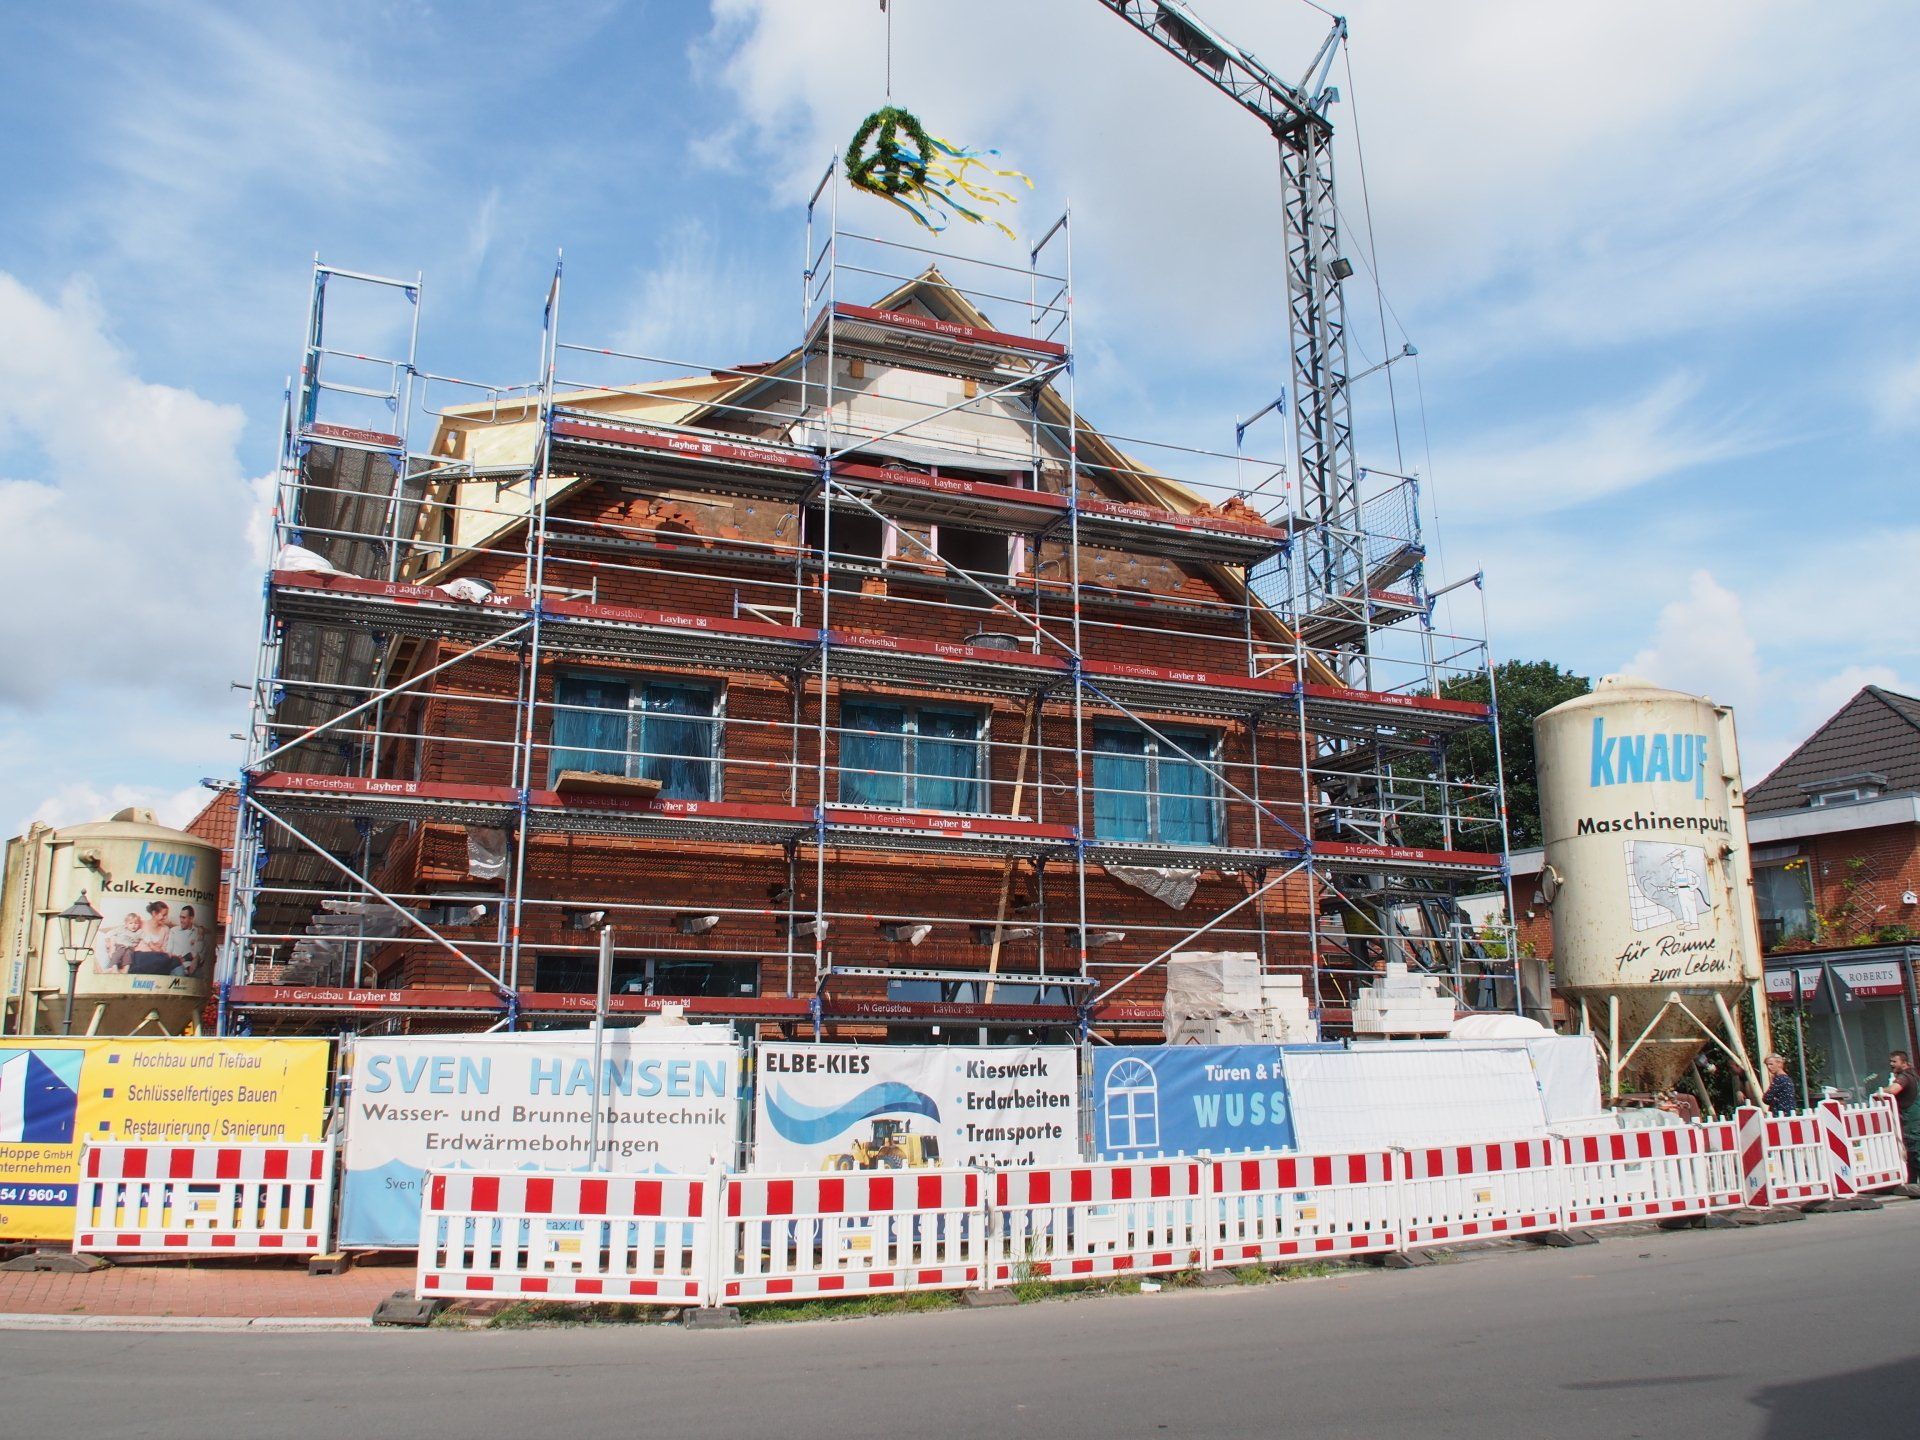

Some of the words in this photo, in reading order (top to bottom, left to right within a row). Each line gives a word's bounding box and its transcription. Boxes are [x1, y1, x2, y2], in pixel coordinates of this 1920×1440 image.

[935, 322, 963, 335] Layher
[668, 438, 701, 452] Layher
[934, 478, 963, 490] Layher
[659, 614, 693, 626] Layher
[935, 643, 963, 656] Layher
[1169, 670, 1195, 682] Layher
[1590, 716, 1708, 800] KNAUF
[366, 780, 403, 794] Layher
[649, 800, 684, 813] Layher
[928, 817, 960, 830] Layher
[1577, 811, 1729, 836] Maschinenputz
[136, 840, 197, 886] KNAUF
[1772, 975, 1819, 988] CARINE
[1849, 970, 1894, 983] ROBERTS
[348, 991, 387, 1004] Layher
[1133, 1008, 1165, 1017] Gerüstba
[132, 1052, 187, 1069] Hochbau
[190, 1053, 214, 1069] und
[218, 1053, 262, 1069] Tiefbau
[766, 1052, 870, 1075] ELBE-KIES
[966, 1058, 1048, 1079] Kieswerk
[365, 1054, 492, 1094] SVEN
[529, 1058, 727, 1098] HANSEN
[1205, 1063, 1251, 1082] Türen
[1255, 1063, 1268, 1080] &
[127, 1084, 235, 1107] Schlüsselfertiges
[238, 1086, 278, 1103] Bauen
[966, 1089, 1070, 1110] Erdarbeiten
[362, 1103, 449, 1122] Wasser-
[461, 1106, 500, 1123] und
[512, 1106, 727, 1126] Brunnenbautechnik
[1192, 1091, 1286, 1128] WUSS
[124, 1118, 210, 1137] Restaurierung
[221, 1119, 286, 1137] Sanierung
[966, 1122, 1062, 1145] Transporte
[425, 1133, 660, 1157] Erdwärmebohrungen
[0, 1147, 40, 1162] Hoppe
[43, 1149, 73, 1160] GmbH
[386, 1177, 415, 1190] Sven
[28, 1188, 68, 1202] 960-0
